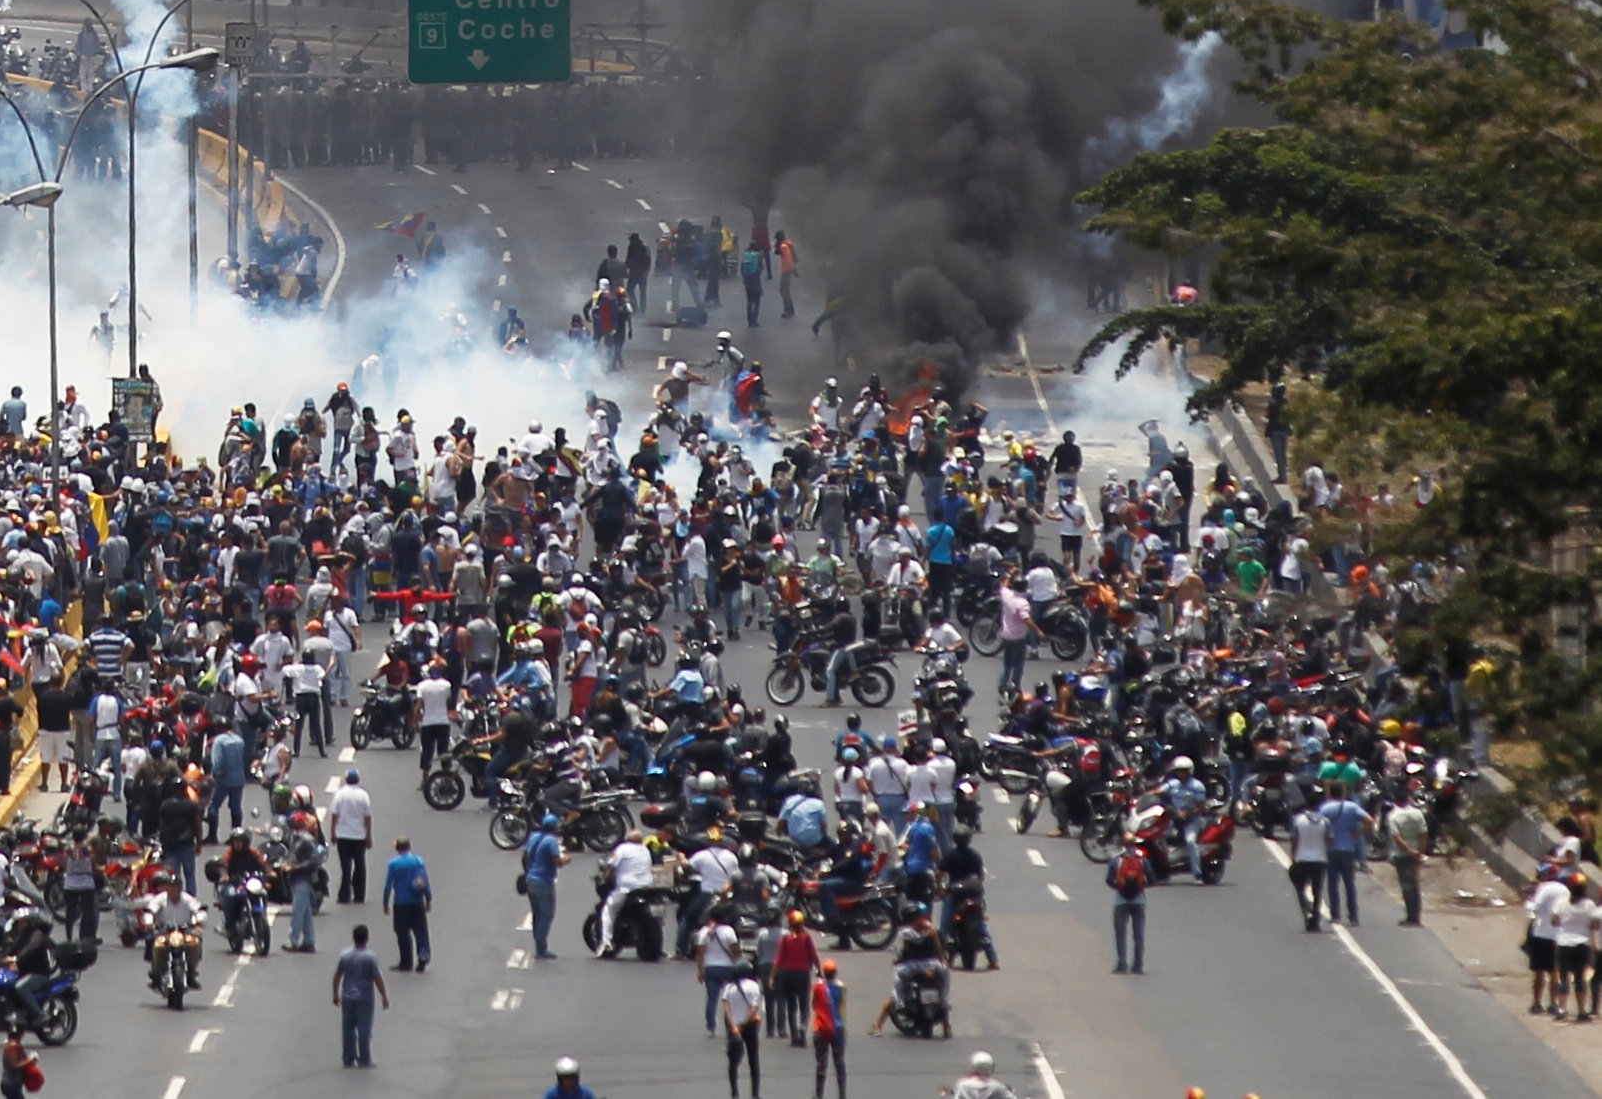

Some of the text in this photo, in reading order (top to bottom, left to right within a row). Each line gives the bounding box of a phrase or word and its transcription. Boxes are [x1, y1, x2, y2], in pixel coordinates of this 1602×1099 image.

[417, 12, 448, 21] OESTE
[426, 28, 437, 43] 9
[458, 19, 556, 40] Coche
